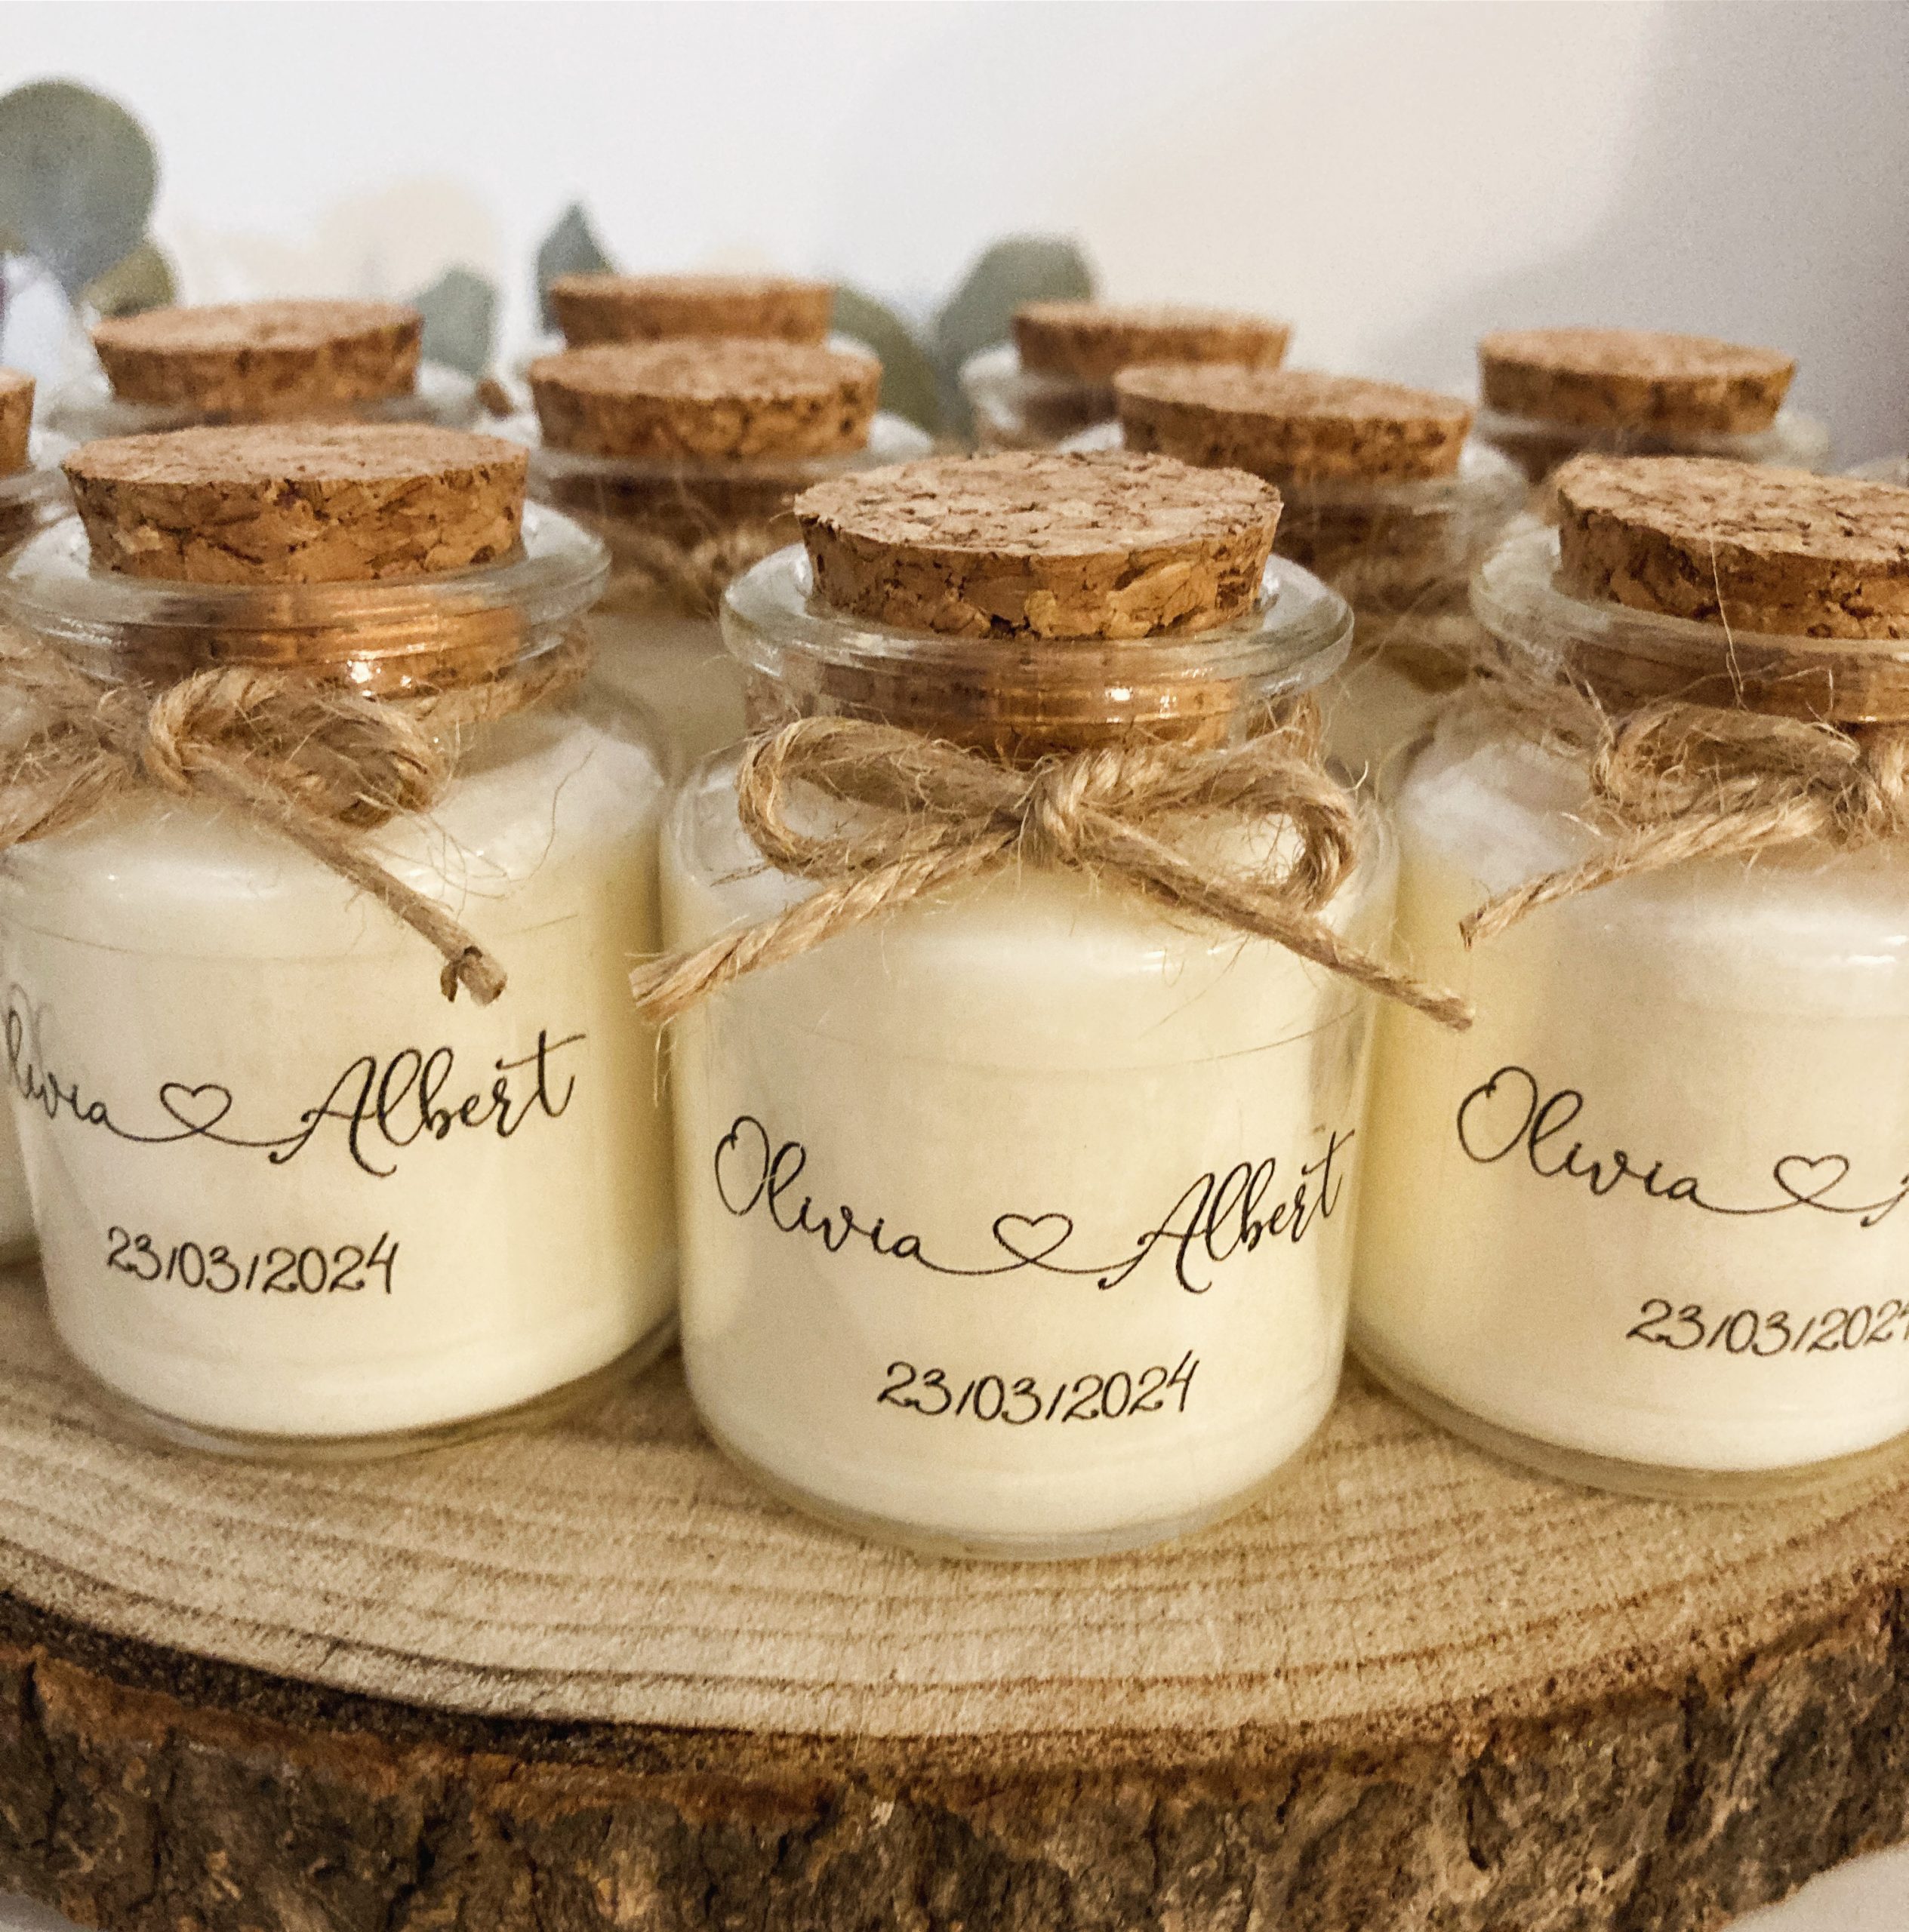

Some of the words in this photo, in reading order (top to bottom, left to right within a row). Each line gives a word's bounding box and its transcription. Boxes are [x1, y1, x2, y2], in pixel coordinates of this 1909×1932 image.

[4, 1006, 121, 1137] livia
[268, 1029, 587, 1178] Albert
[1456, 1064, 1717, 1211] Olivia
[106, 1225, 401, 1295] 23/03/2024
[713, 1114, 938, 1268] Olivia
[1097, 1128, 1356, 1295] Albert
[876, 1349, 1200, 1425] 23/03/2024
